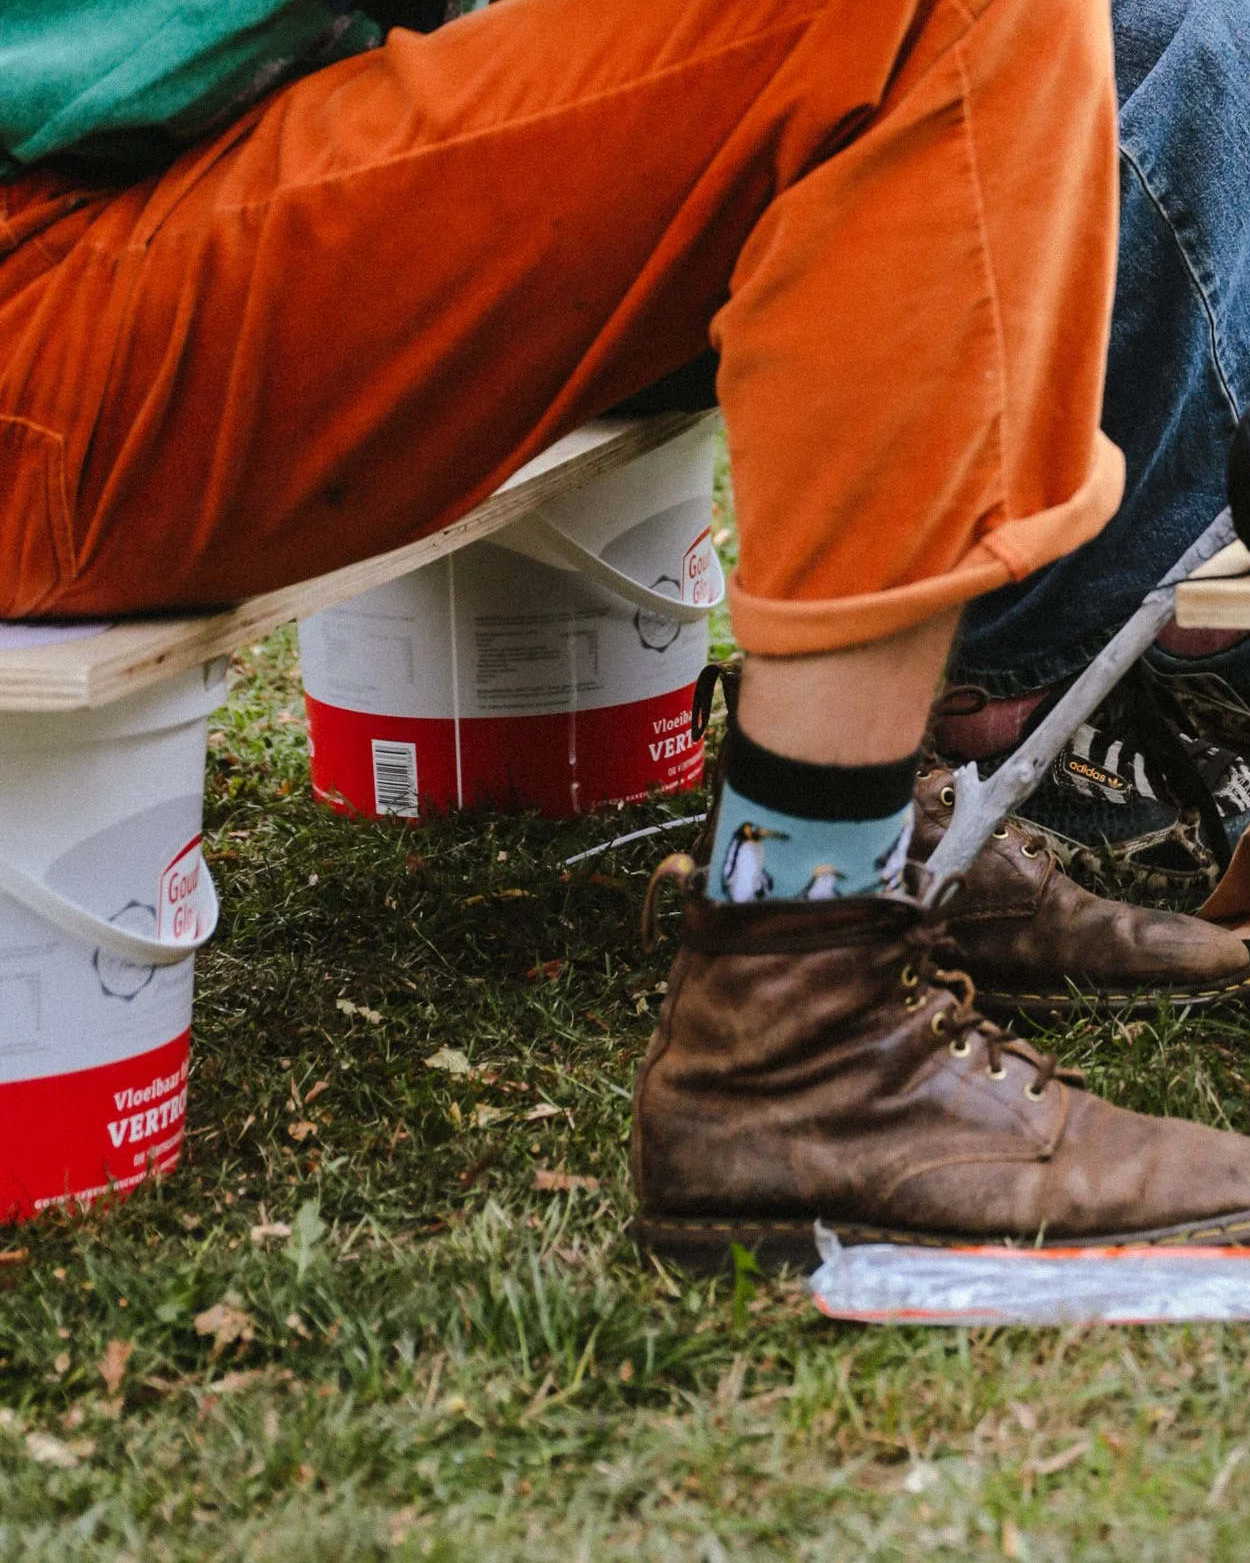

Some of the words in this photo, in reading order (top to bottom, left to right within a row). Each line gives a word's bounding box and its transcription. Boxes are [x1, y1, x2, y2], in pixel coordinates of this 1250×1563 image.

[1069, 760, 1107, 783] adidas
[113, 1070, 181, 1112] Vloeibaar
[106, 1088, 187, 1148] VERTRO
